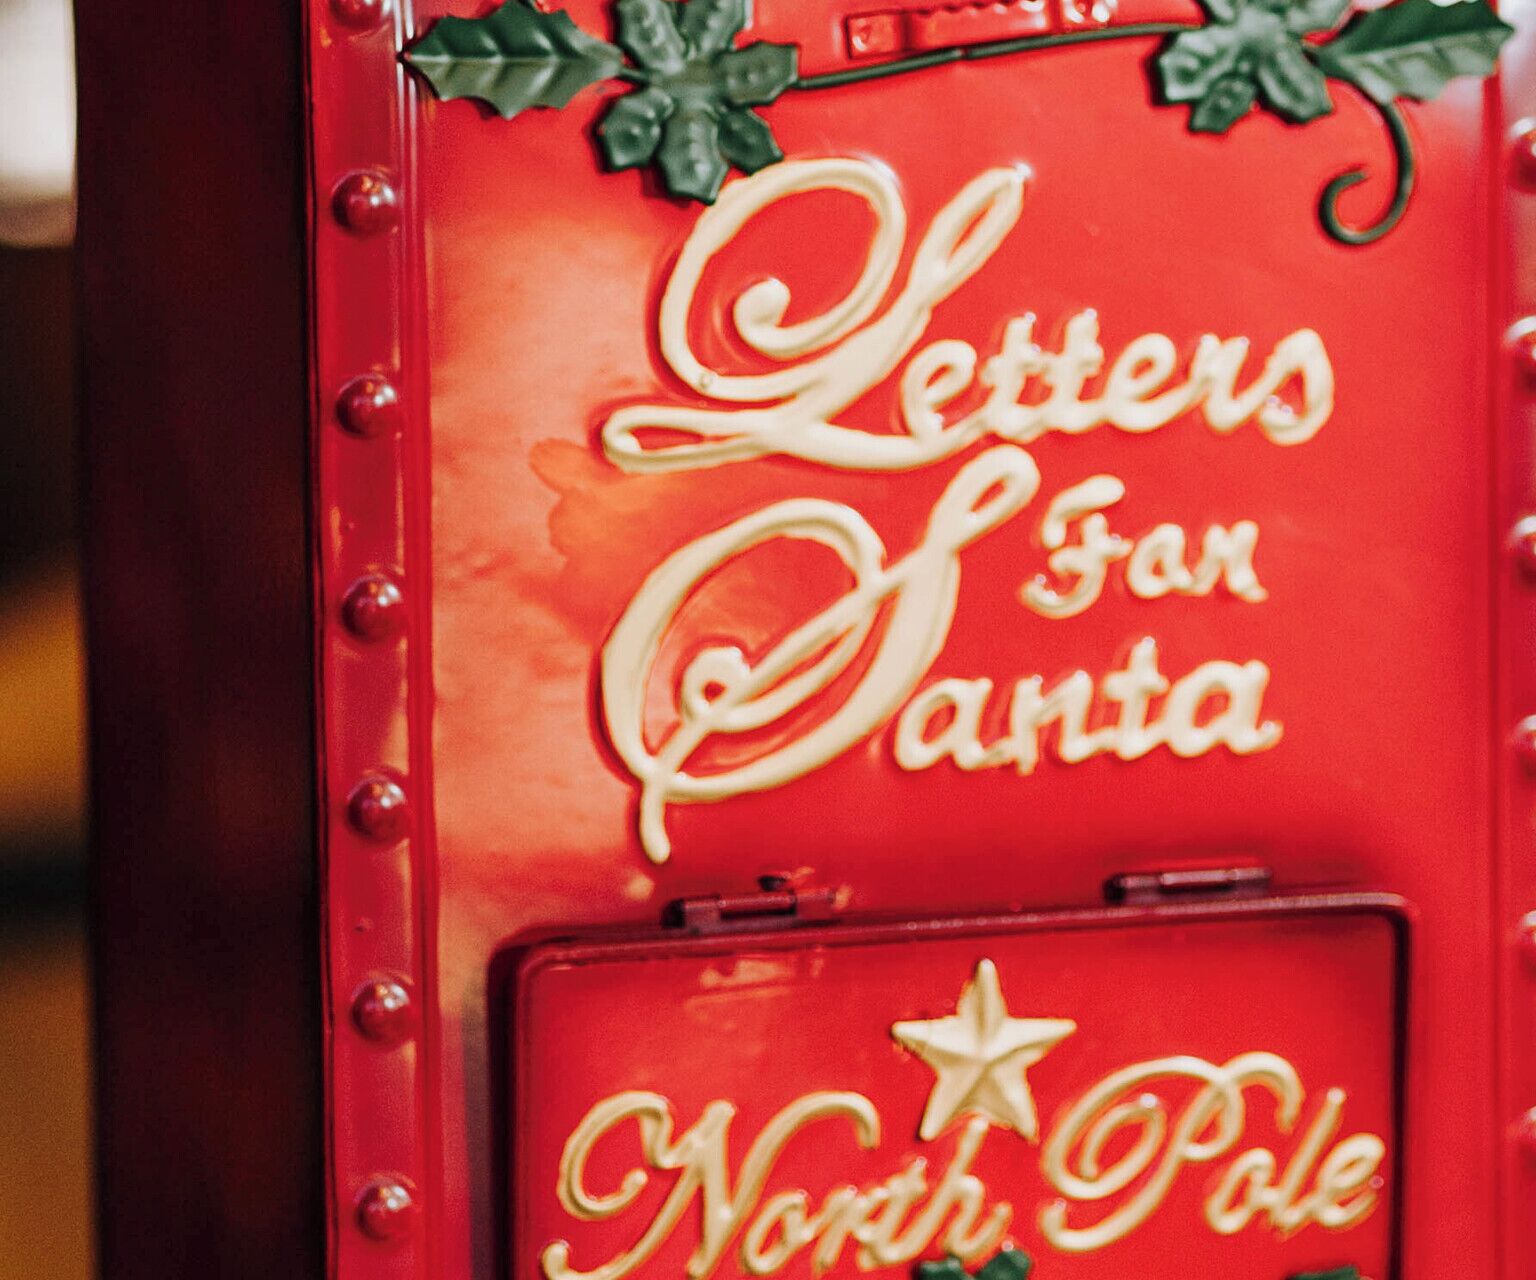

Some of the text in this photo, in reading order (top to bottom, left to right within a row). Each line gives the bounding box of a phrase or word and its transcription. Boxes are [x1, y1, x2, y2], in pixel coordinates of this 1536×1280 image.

[604, 156, 1335, 473] Letters
[600, 443, 1283, 865] Santa
[1038, 1052, 1387, 1253] Pole
